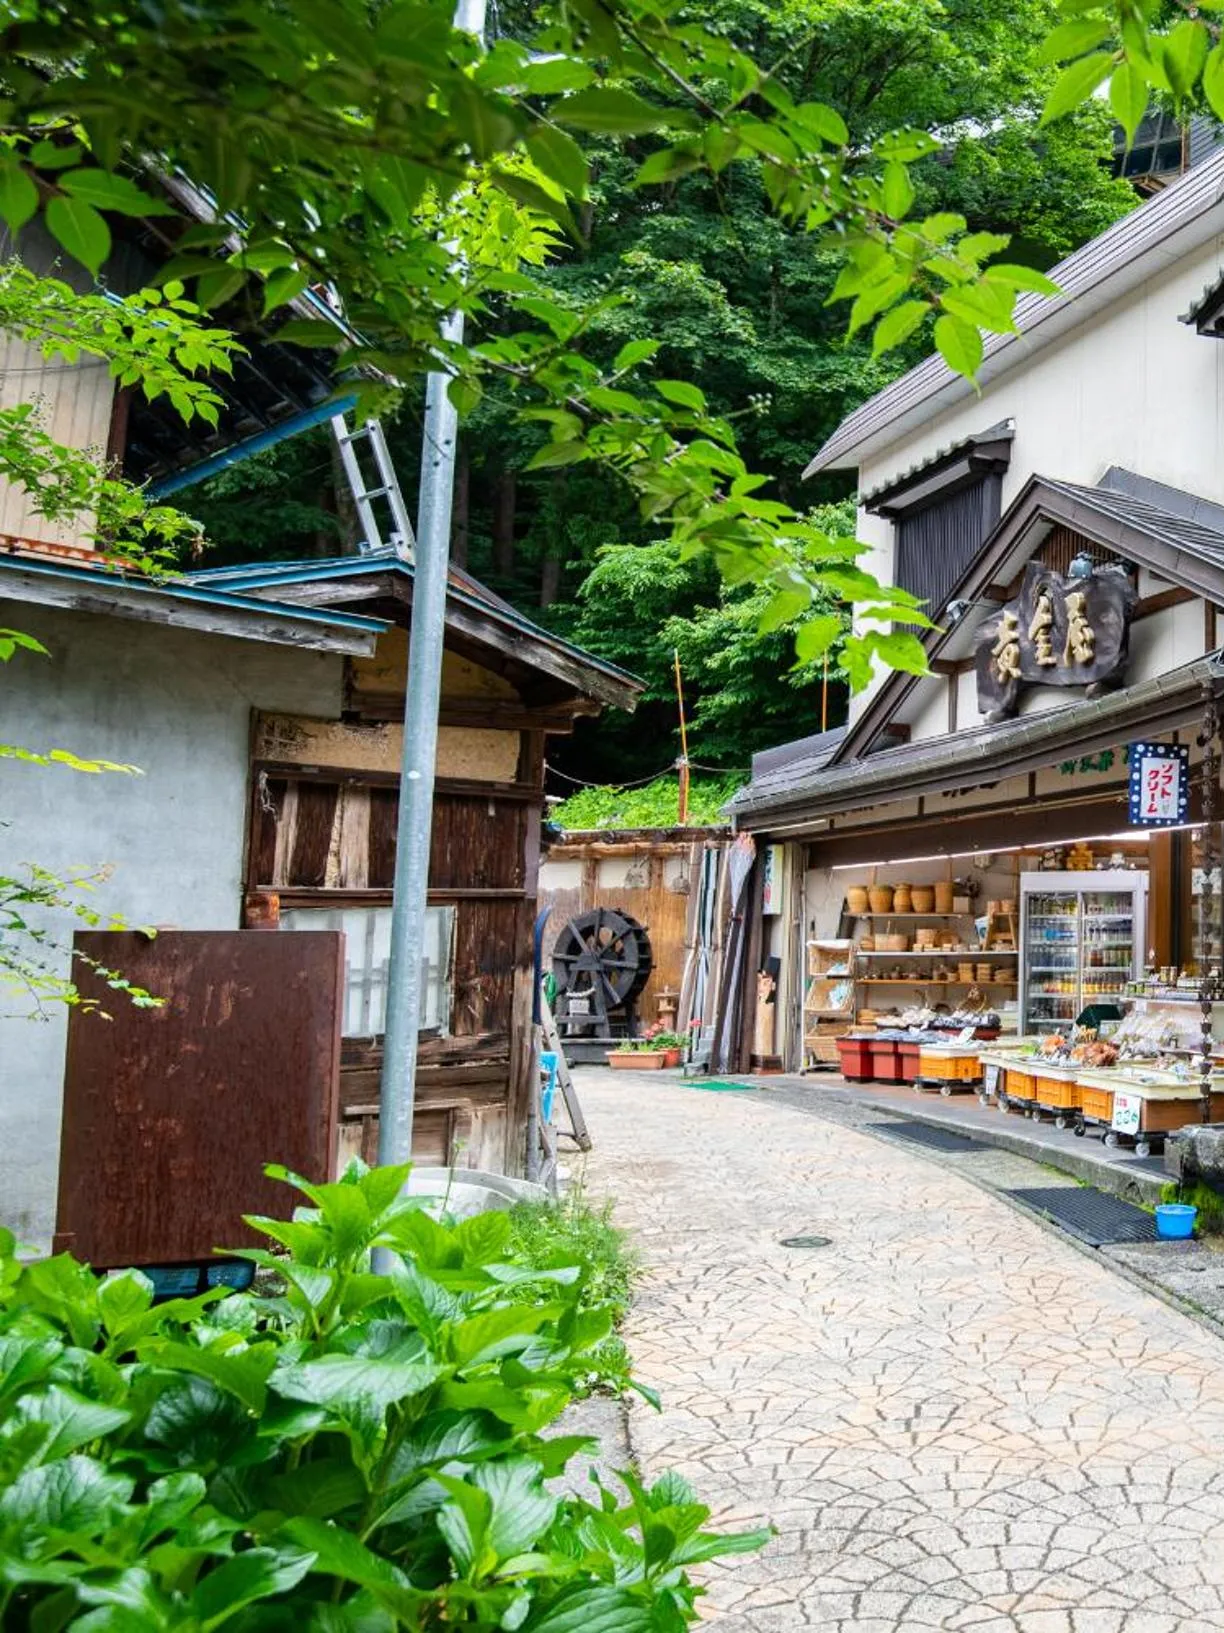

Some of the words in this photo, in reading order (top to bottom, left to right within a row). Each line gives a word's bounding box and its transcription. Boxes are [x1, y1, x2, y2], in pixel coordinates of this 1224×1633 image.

[1146, 770, 1160, 813] クリーム
[1161, 763, 1173, 799] ソフト
